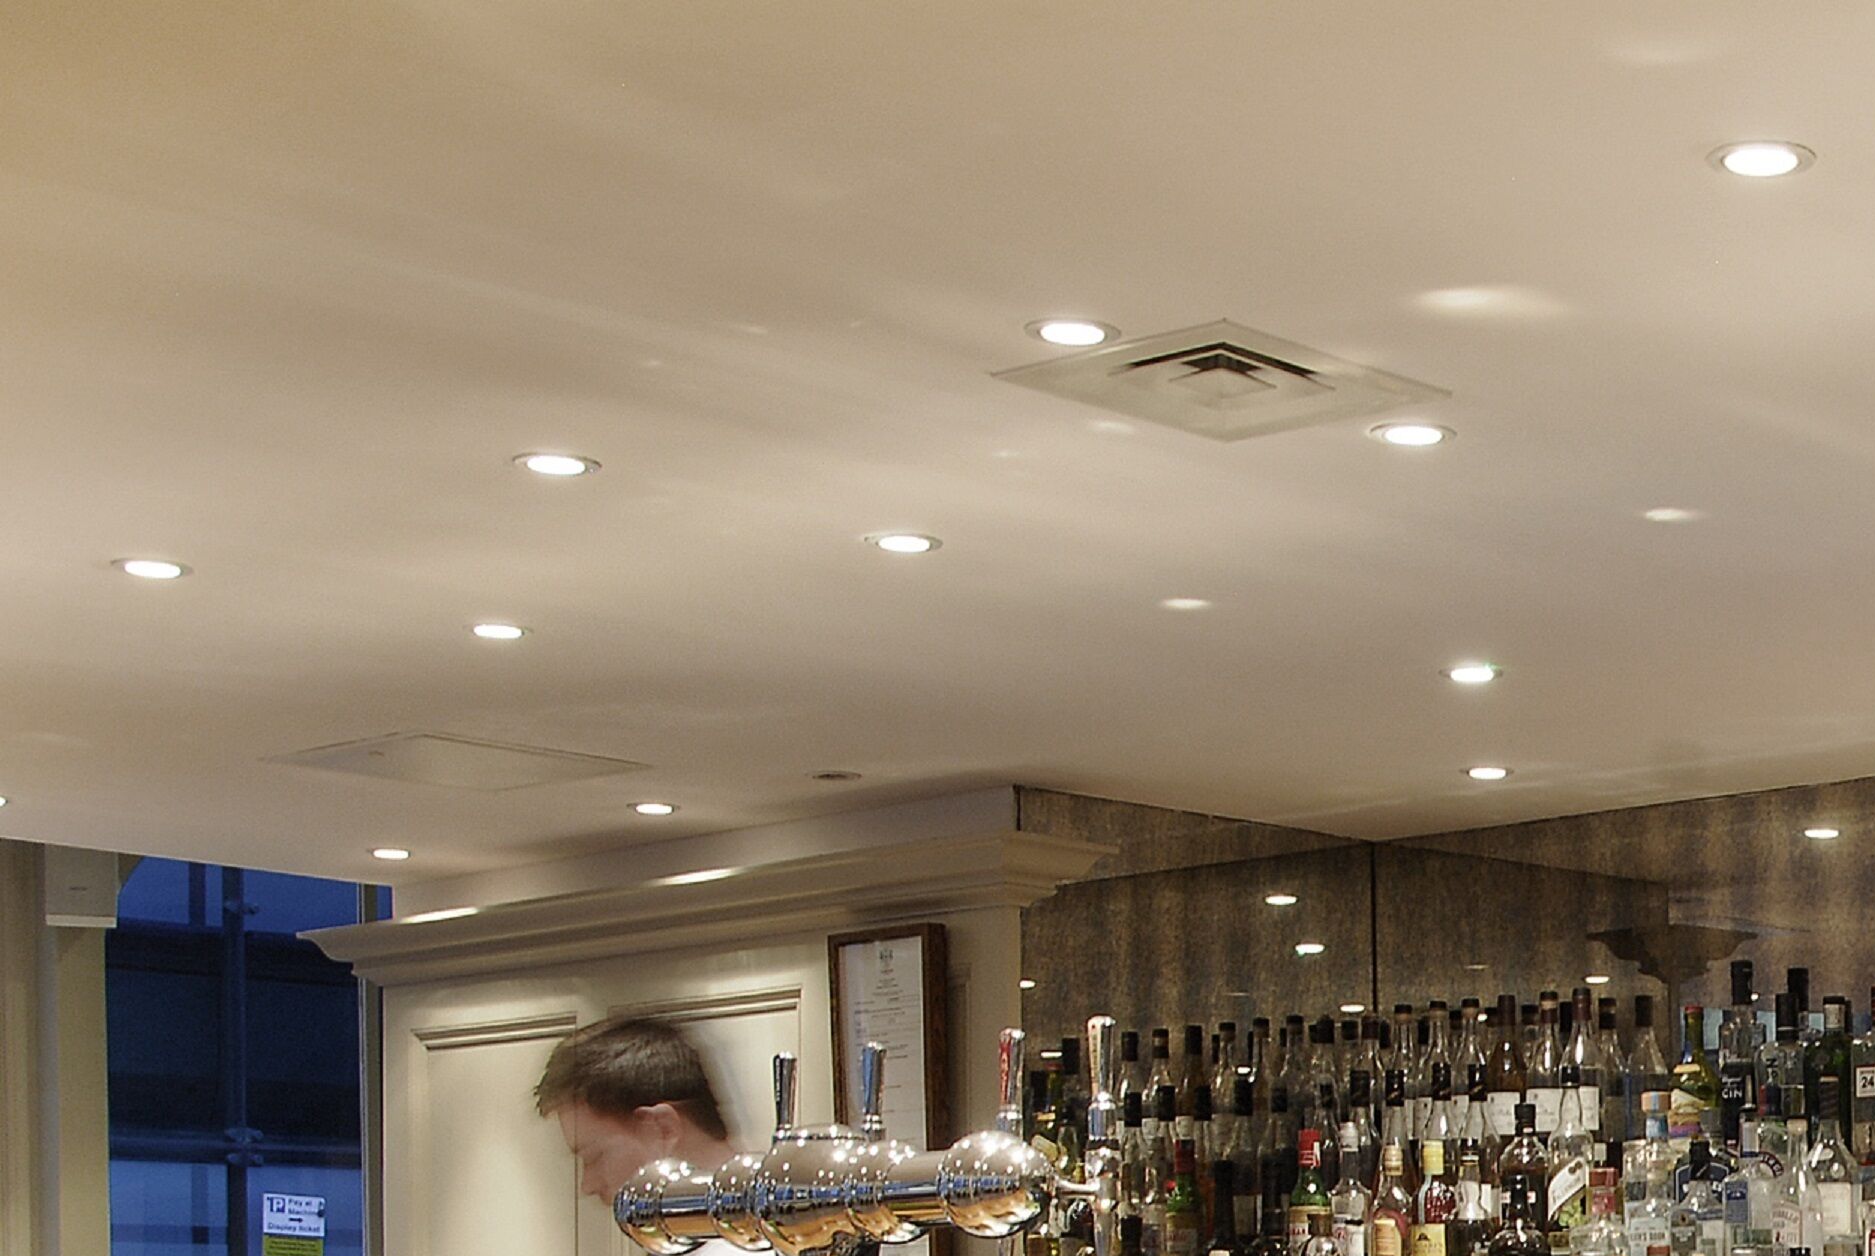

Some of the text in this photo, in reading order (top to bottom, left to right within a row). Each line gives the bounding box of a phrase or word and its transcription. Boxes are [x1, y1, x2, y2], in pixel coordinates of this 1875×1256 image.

[1861, 1075, 1875, 1089] 24
[1721, 1088, 1743, 1099] GIN
[267, 1222, 297, 1232] Display
